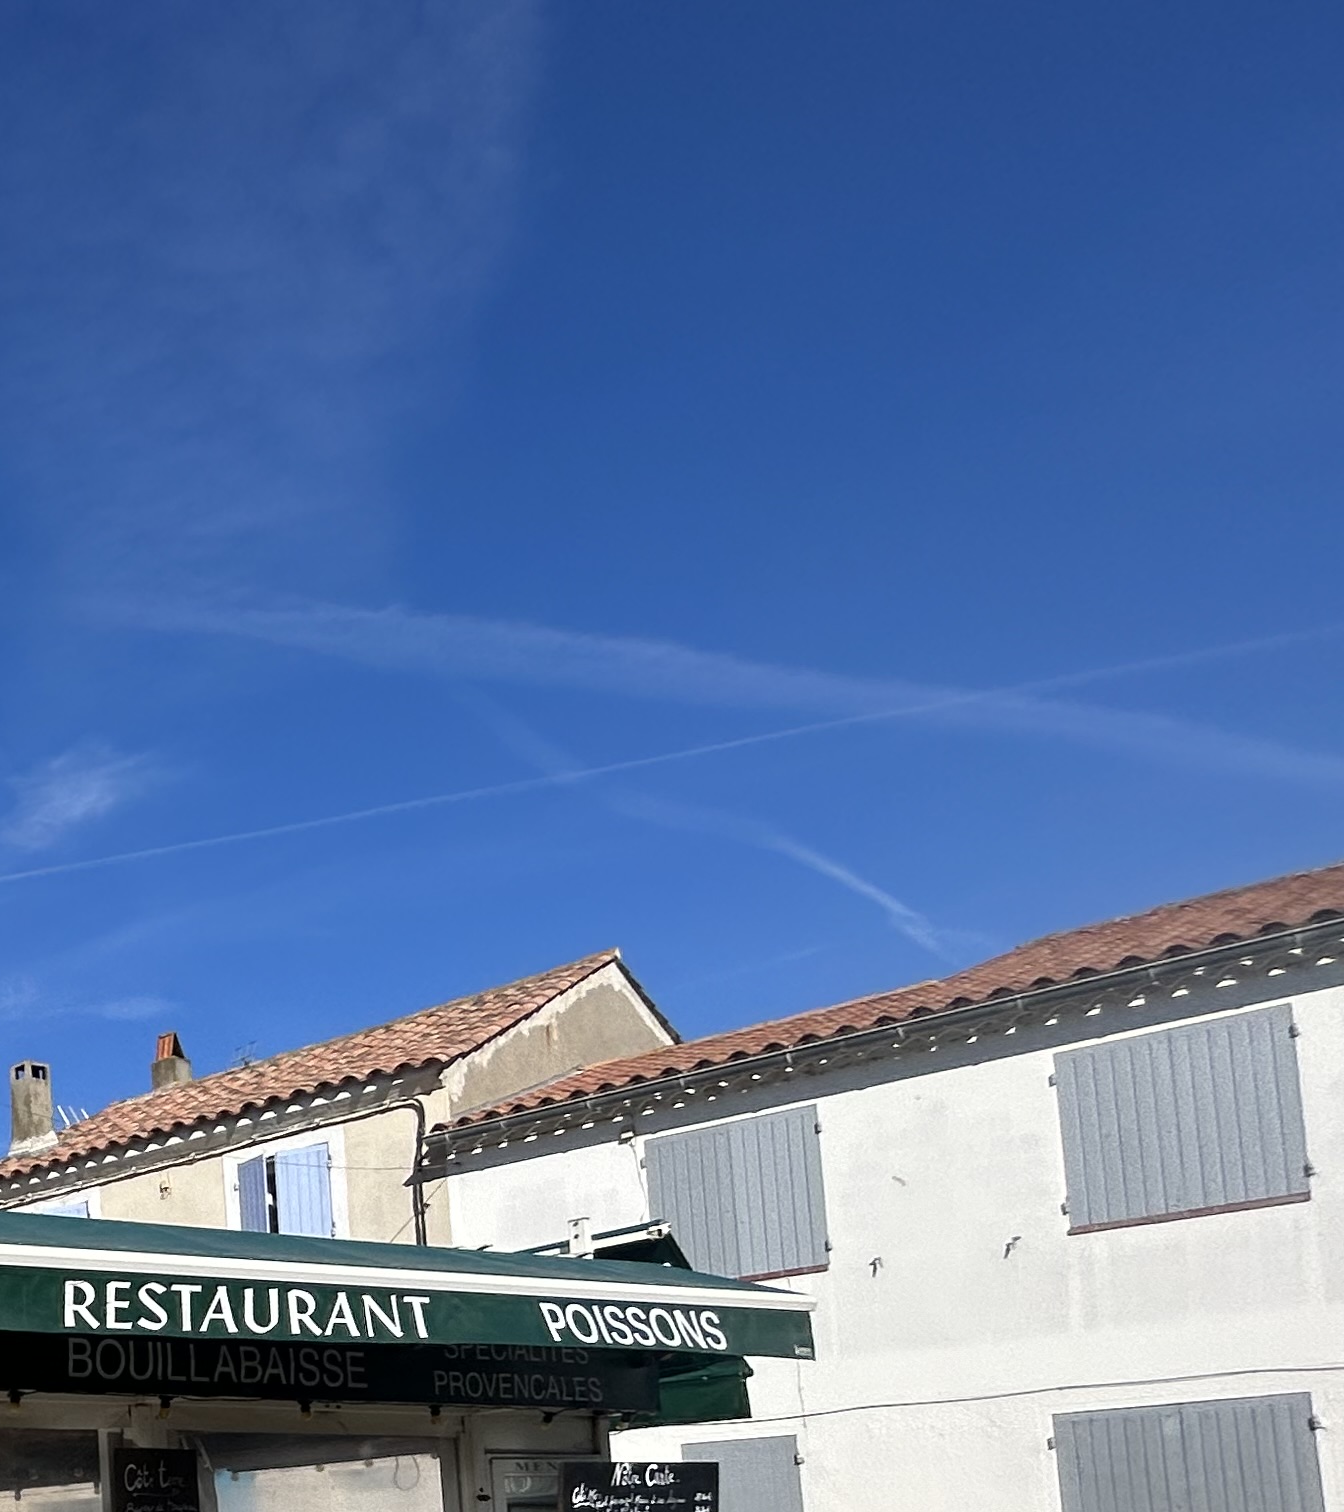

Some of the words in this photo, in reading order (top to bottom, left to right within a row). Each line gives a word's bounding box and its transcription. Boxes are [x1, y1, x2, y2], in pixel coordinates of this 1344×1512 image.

[63, 1279, 430, 1339] RESTAURANT
[538, 1301, 729, 1351] POISSONS
[67, 1337, 369, 1389] BOUILLABAISSE
[443, 1344, 590, 1365] SPECIALITES
[433, 1370, 604, 1403] PROVENCALES
